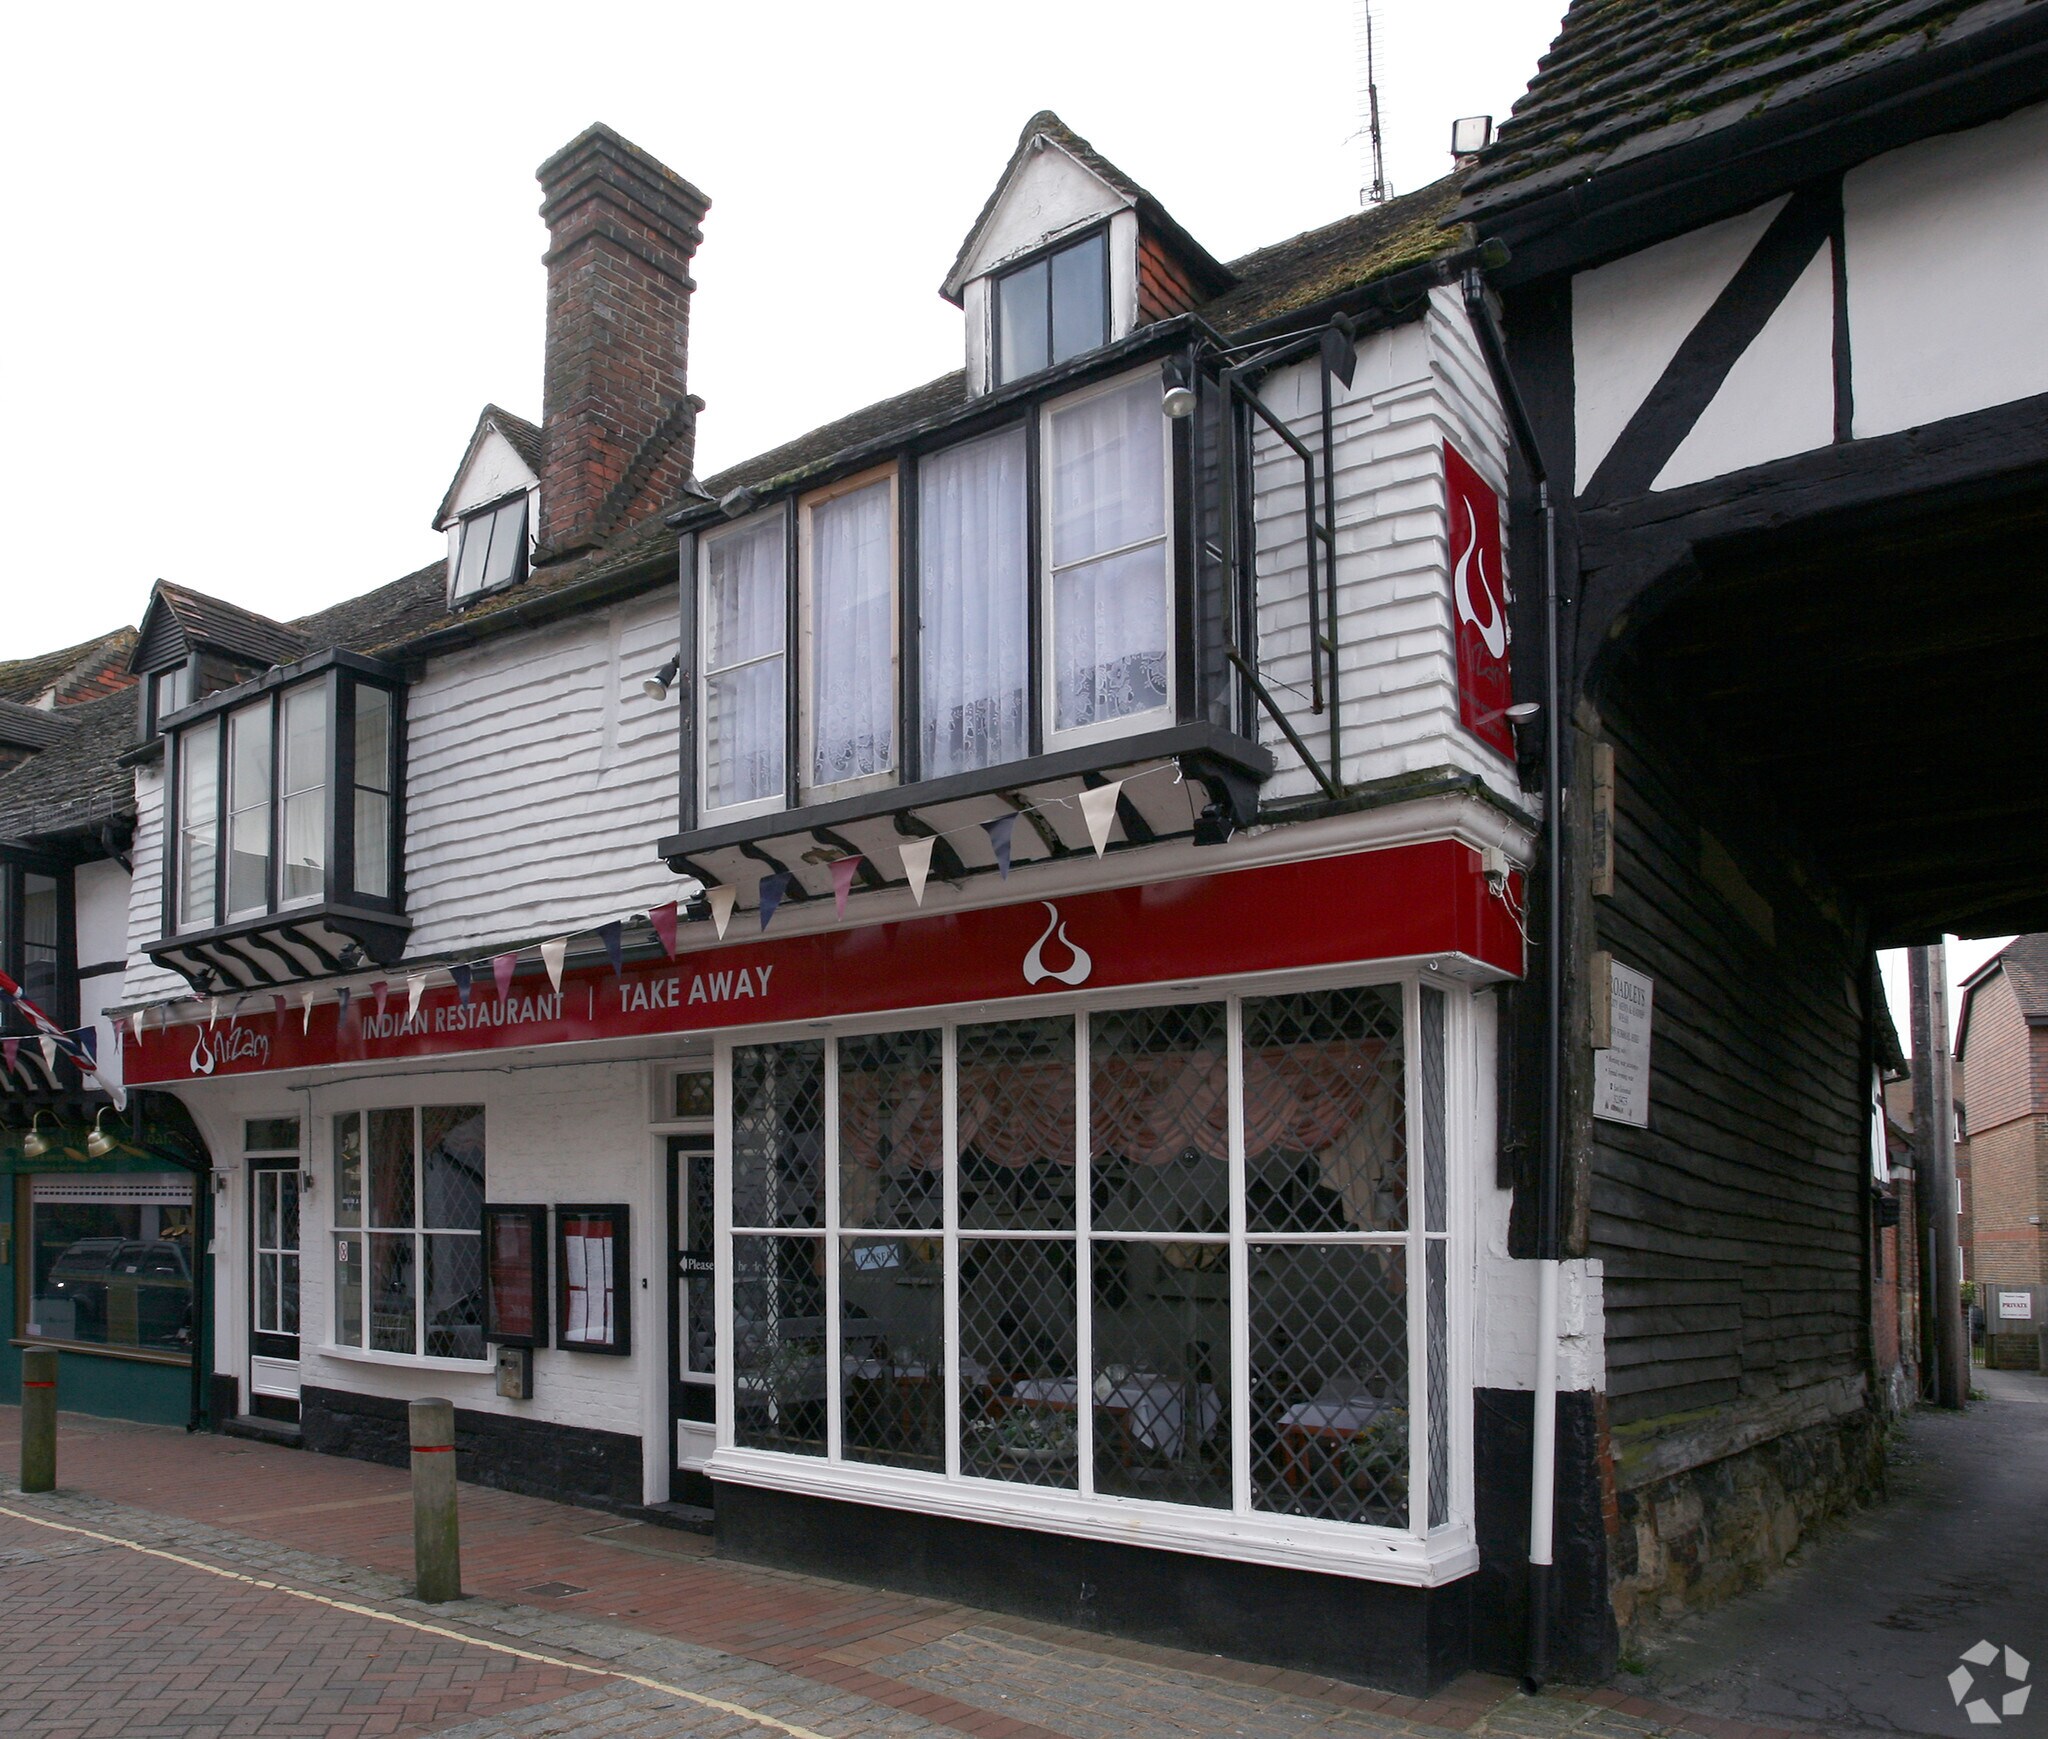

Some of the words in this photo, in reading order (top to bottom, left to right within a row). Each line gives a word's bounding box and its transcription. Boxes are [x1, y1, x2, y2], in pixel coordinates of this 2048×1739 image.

[619, 977, 680, 1013] TAKE
[687, 965, 773, 1006] AWAY
[362, 1009, 428, 1040] INDIAN
[435, 992, 564, 1032] RESTAURANT
[688, 1258, 715, 1271] Please
